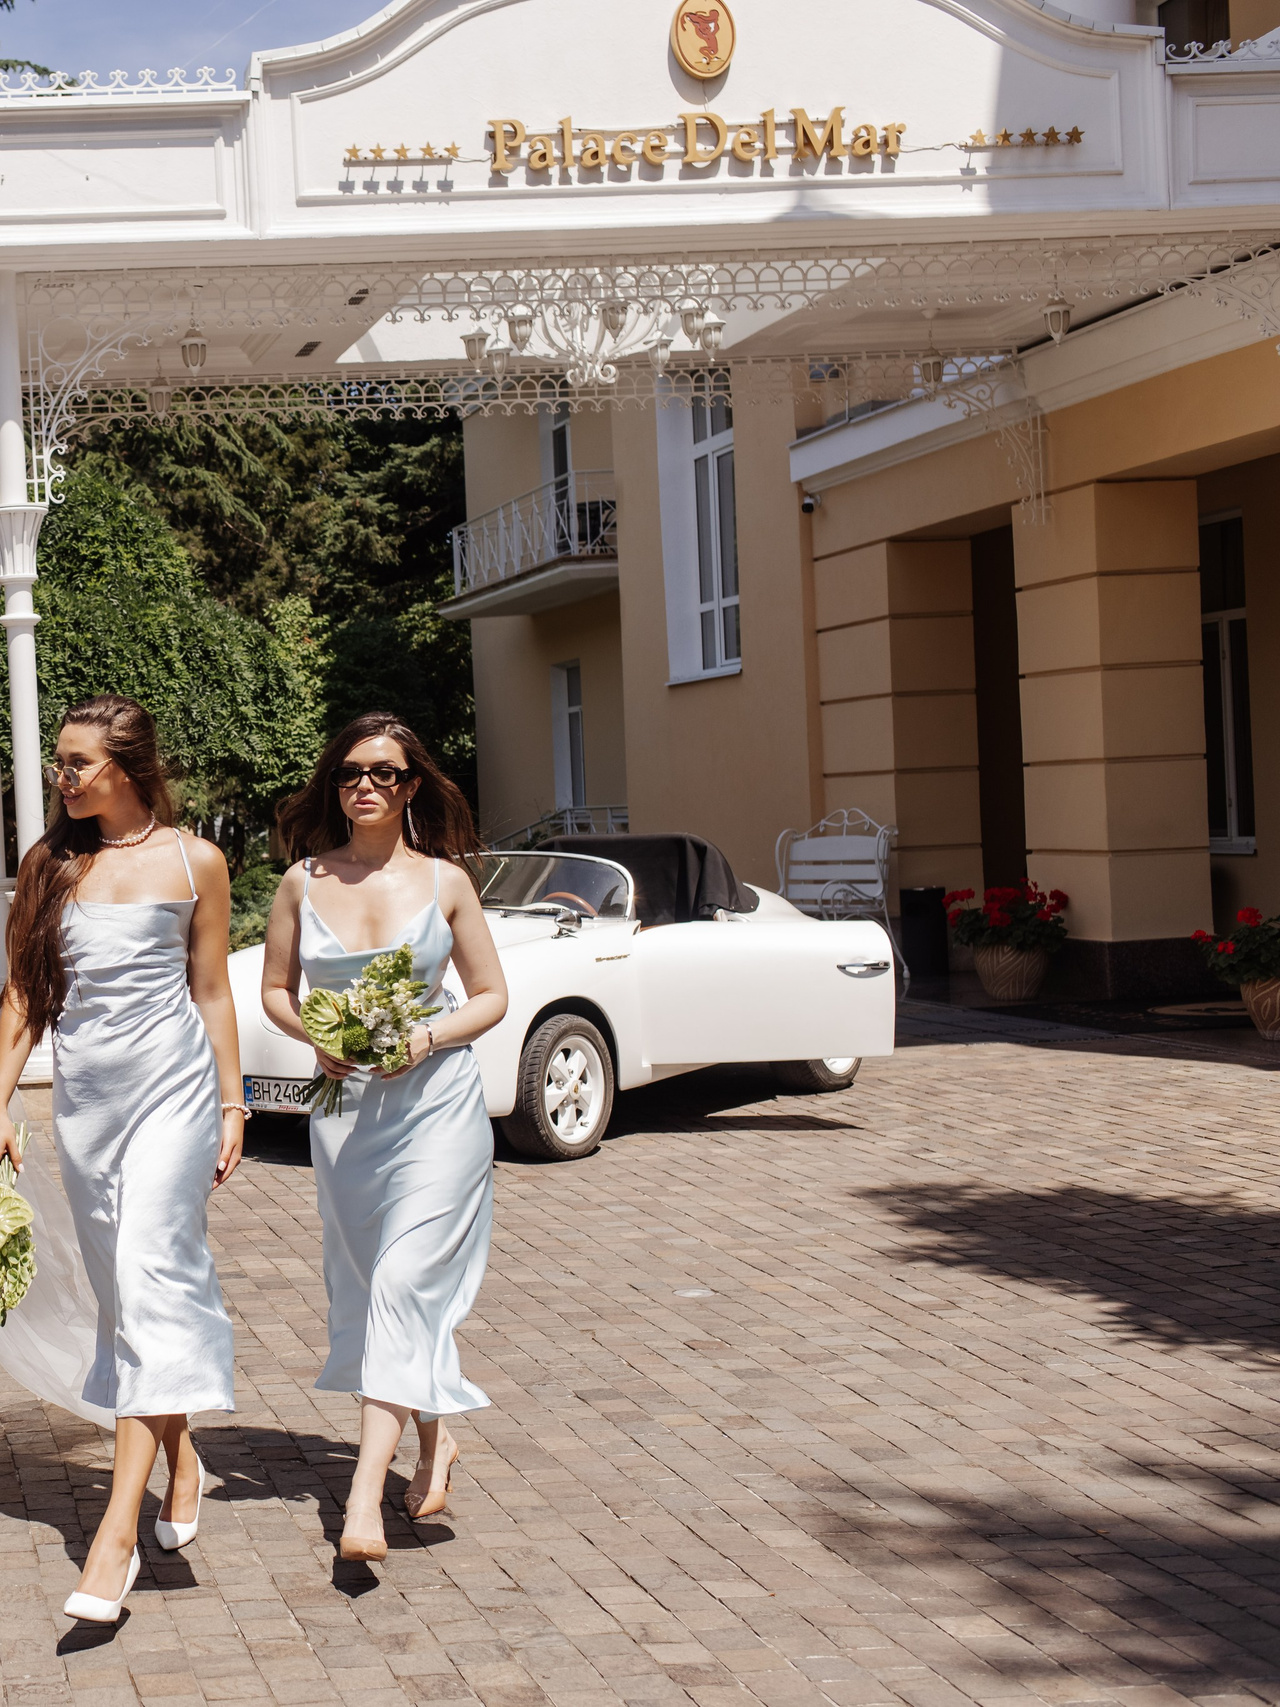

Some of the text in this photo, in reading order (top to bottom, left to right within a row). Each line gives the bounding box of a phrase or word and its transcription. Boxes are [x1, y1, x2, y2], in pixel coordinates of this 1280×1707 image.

[488, 106, 907, 171] Palace Del Mar
[252, 1081, 271, 1101] BH
